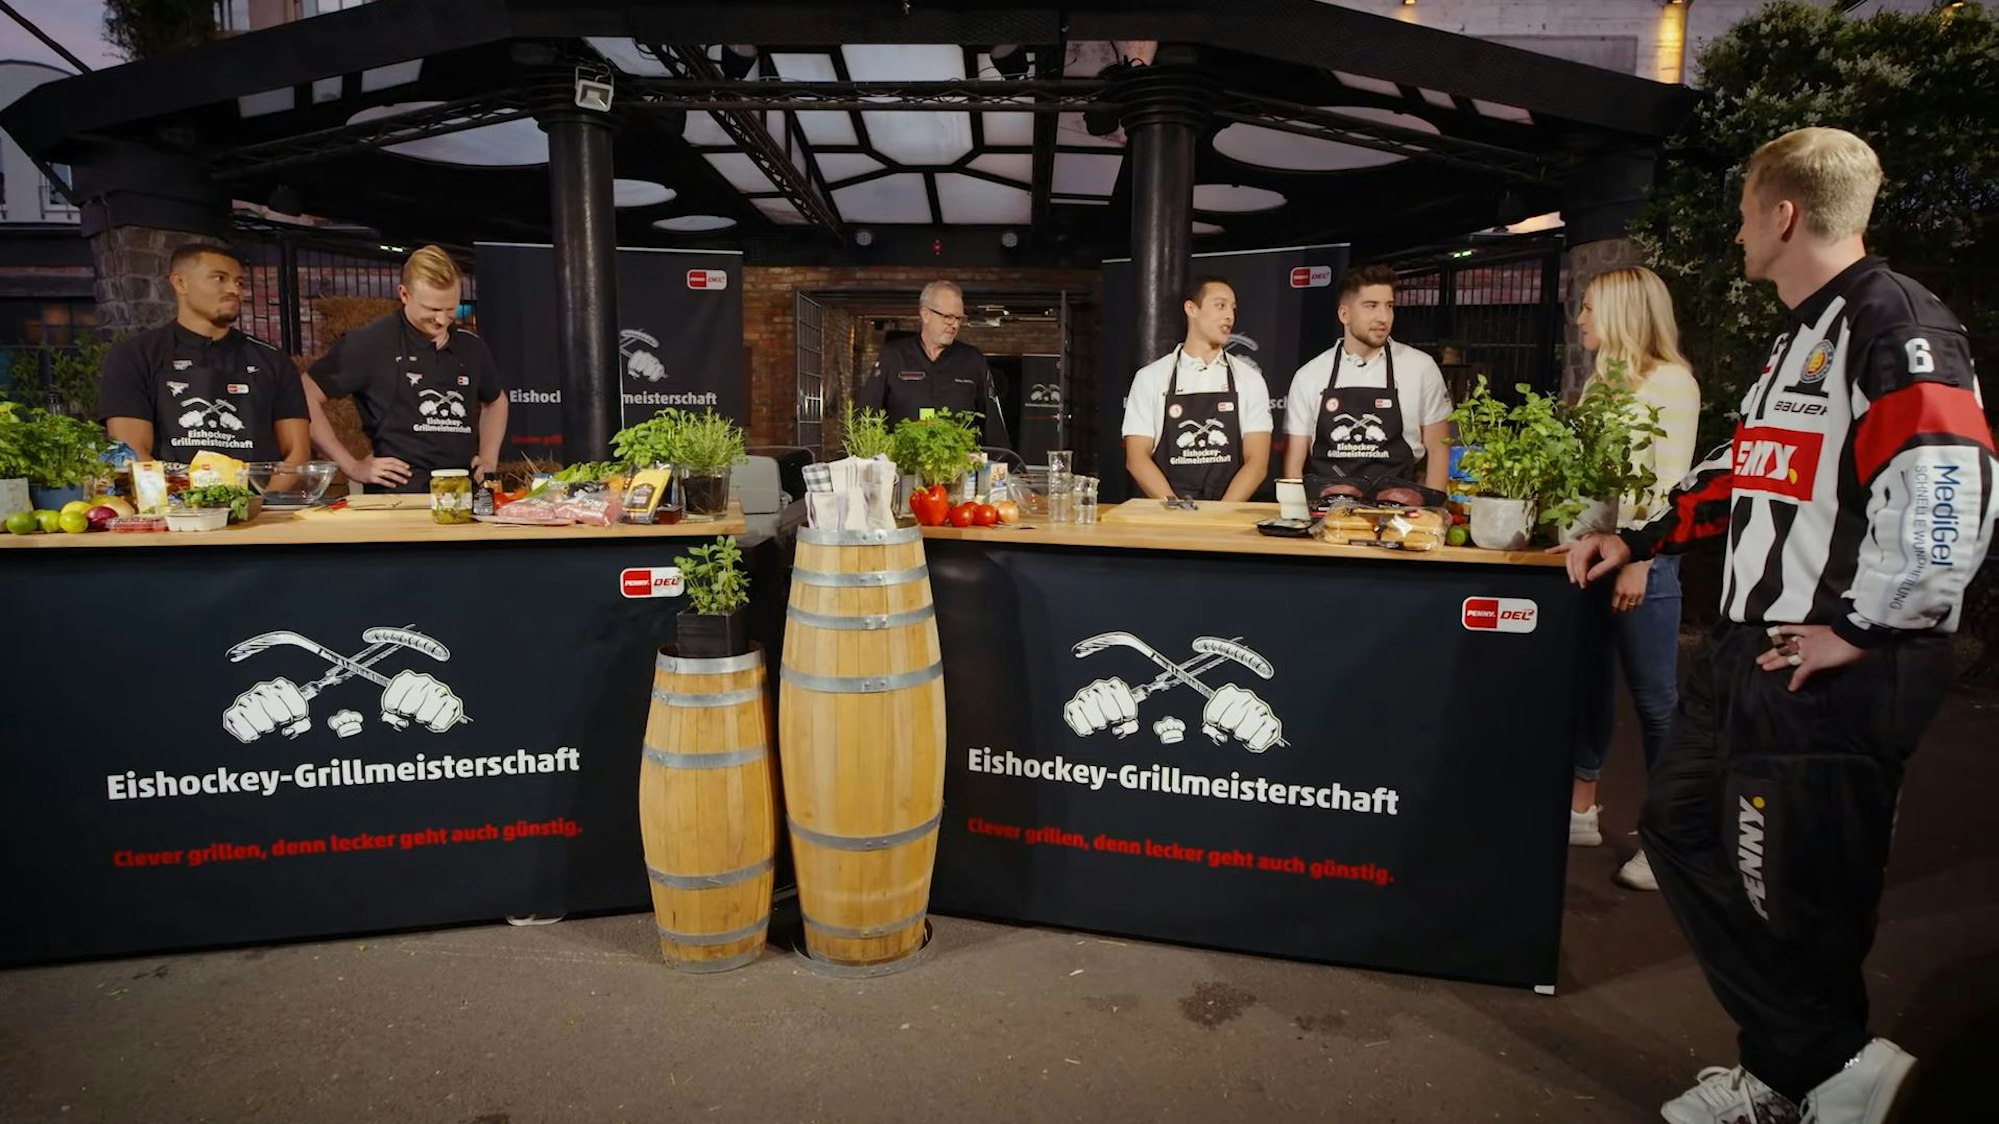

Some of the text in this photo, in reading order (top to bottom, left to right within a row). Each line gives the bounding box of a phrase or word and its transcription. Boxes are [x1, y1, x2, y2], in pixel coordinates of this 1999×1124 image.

[1904, 337, 1935, 374] 6
[171, 437, 254, 448] Grillmeisterschaft
[188, 429, 236, 441] Eishockey-
[1930, 465, 1961, 566] MediGel
[107, 747, 581, 800] Eishockey-Grillmeisterschaft
[968, 747, 1400, 815] Eishockey-Grillmeisterschaft
[113, 818, 582, 867] Clever grillen, denn lecker geht auch günstig.
[967, 817, 1394, 885] Clever grillen, denn lecker geht auch günstig.
